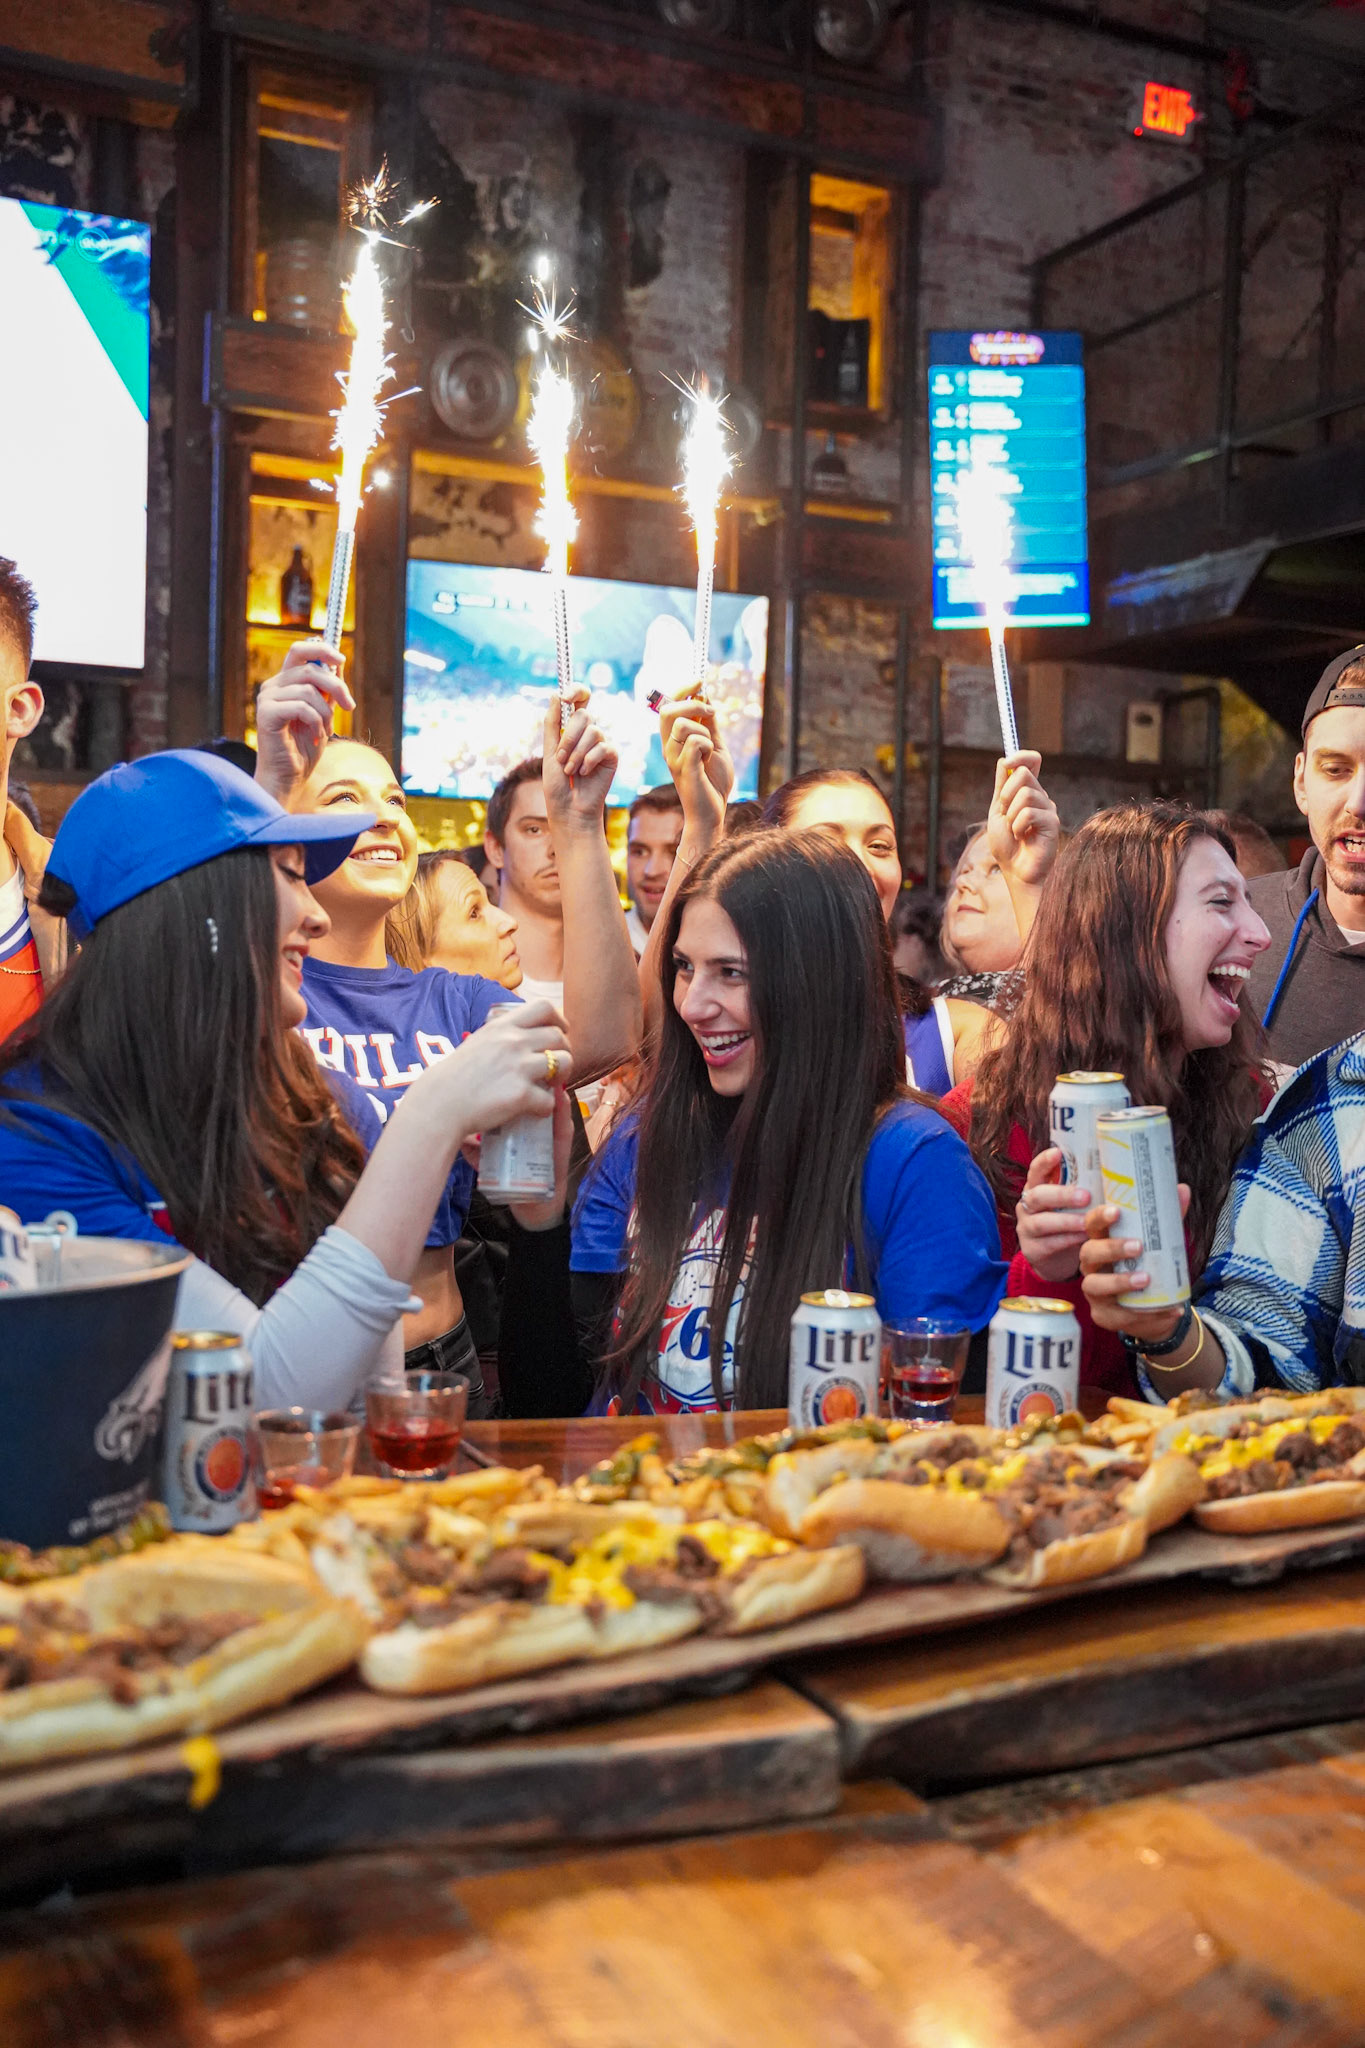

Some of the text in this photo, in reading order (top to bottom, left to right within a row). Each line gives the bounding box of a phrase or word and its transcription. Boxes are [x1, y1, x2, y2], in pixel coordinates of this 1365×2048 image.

[301, 1026, 456, 1089] HIL
[1050, 1100, 1075, 1132] te
[806, 1325, 875, 1373] Lite
[1005, 1330, 1074, 1379] Lite
